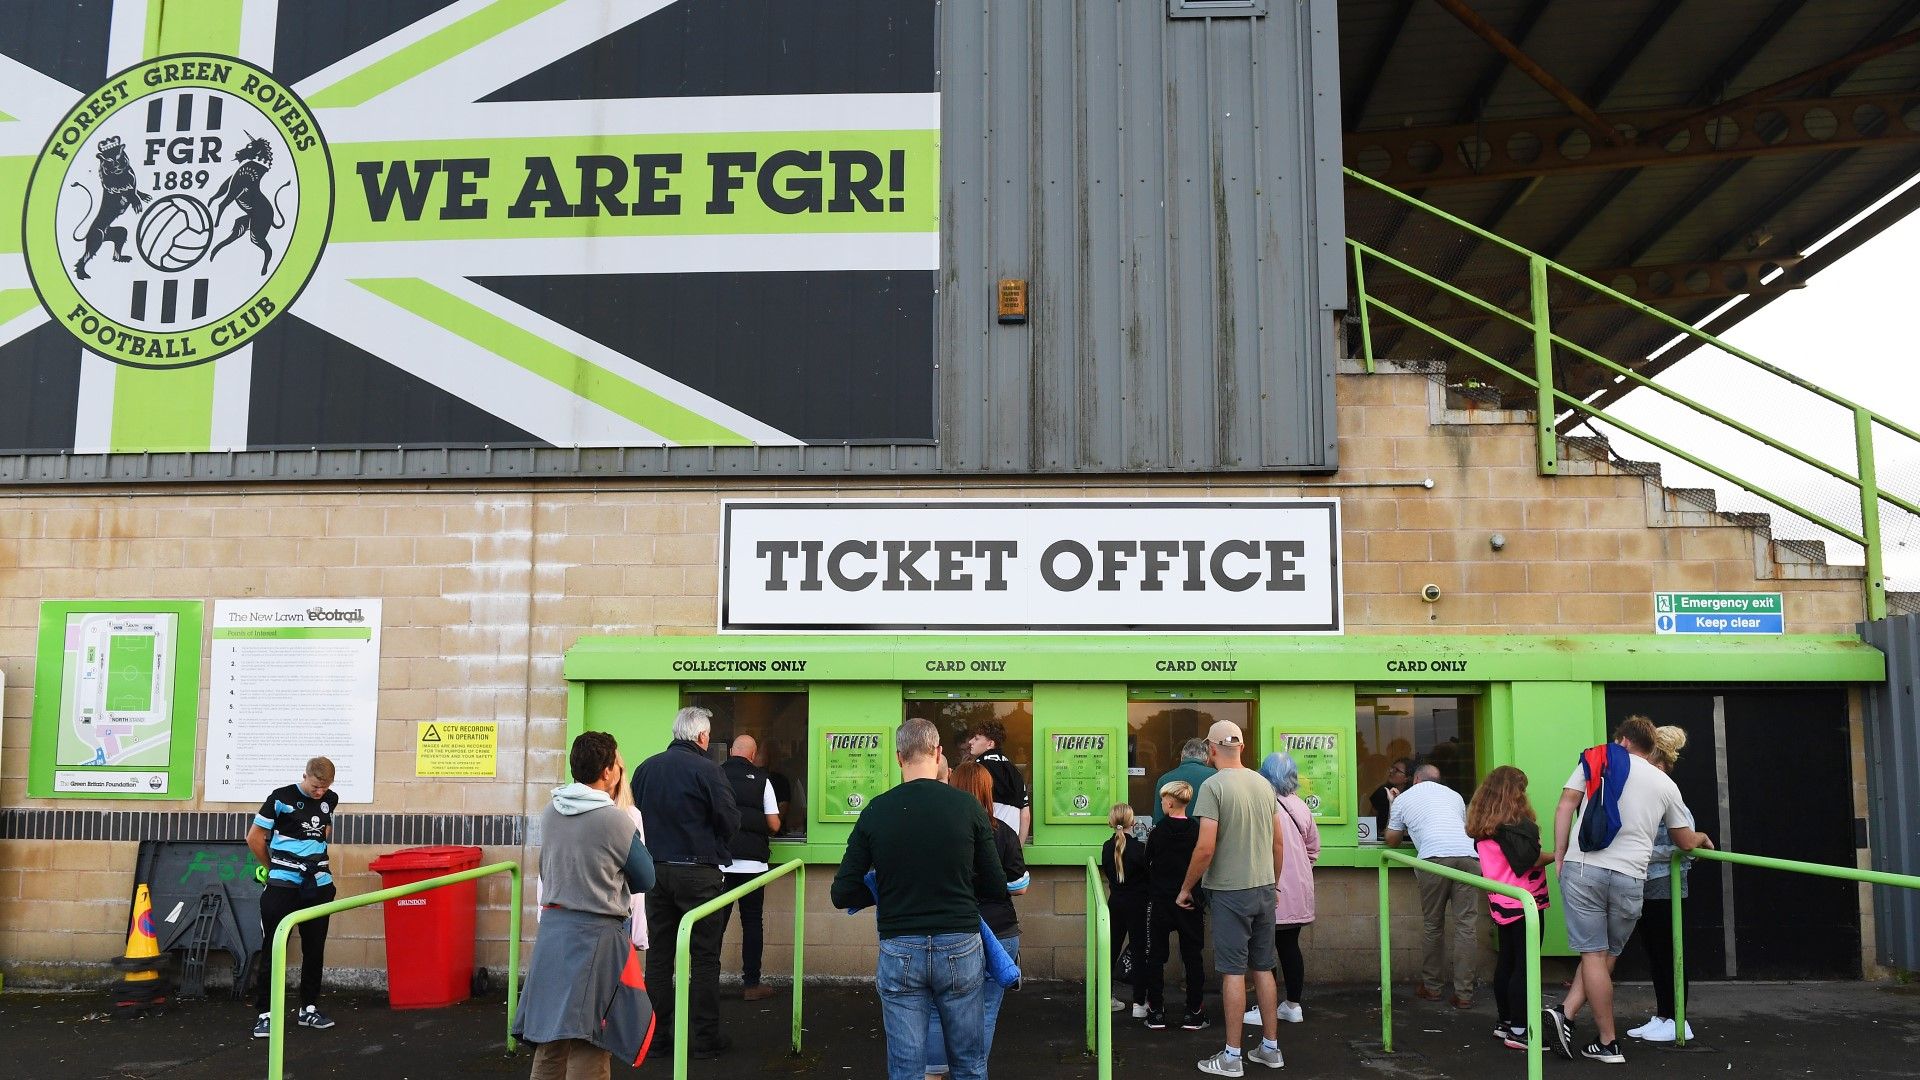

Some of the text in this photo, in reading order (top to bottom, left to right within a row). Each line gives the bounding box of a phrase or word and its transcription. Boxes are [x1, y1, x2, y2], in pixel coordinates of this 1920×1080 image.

[51, 62, 317, 161] FOREST GREEN ROVERS
[143, 135, 222, 166] FGR
[152, 169, 210, 191] 1889
[356, 150, 905, 222] WE ARE FGR!
[66, 296, 277, 359] FOOTBALL CLUB
[756, 539, 1306, 592] TICKET OFFICE
[1681, 597, 1774, 610] Emergency exit
[229, 612, 304, 622] The New Lawn
[309, 608, 362, 622] ecotrail
[1696, 617, 1761, 630] Keep clear
[672, 660, 807, 672] COLLECTIONS ONLY
[925, 660, 1007, 672] CARD ONLY
[1155, 660, 1238, 672] CARD ONLY
[1386, 660, 1468, 672] CARD ONLY
[831, 735, 878, 751] TICKETS
[1056, 736, 1105, 751] TICKETS
[1286, 736, 1335, 751] TICKETS
